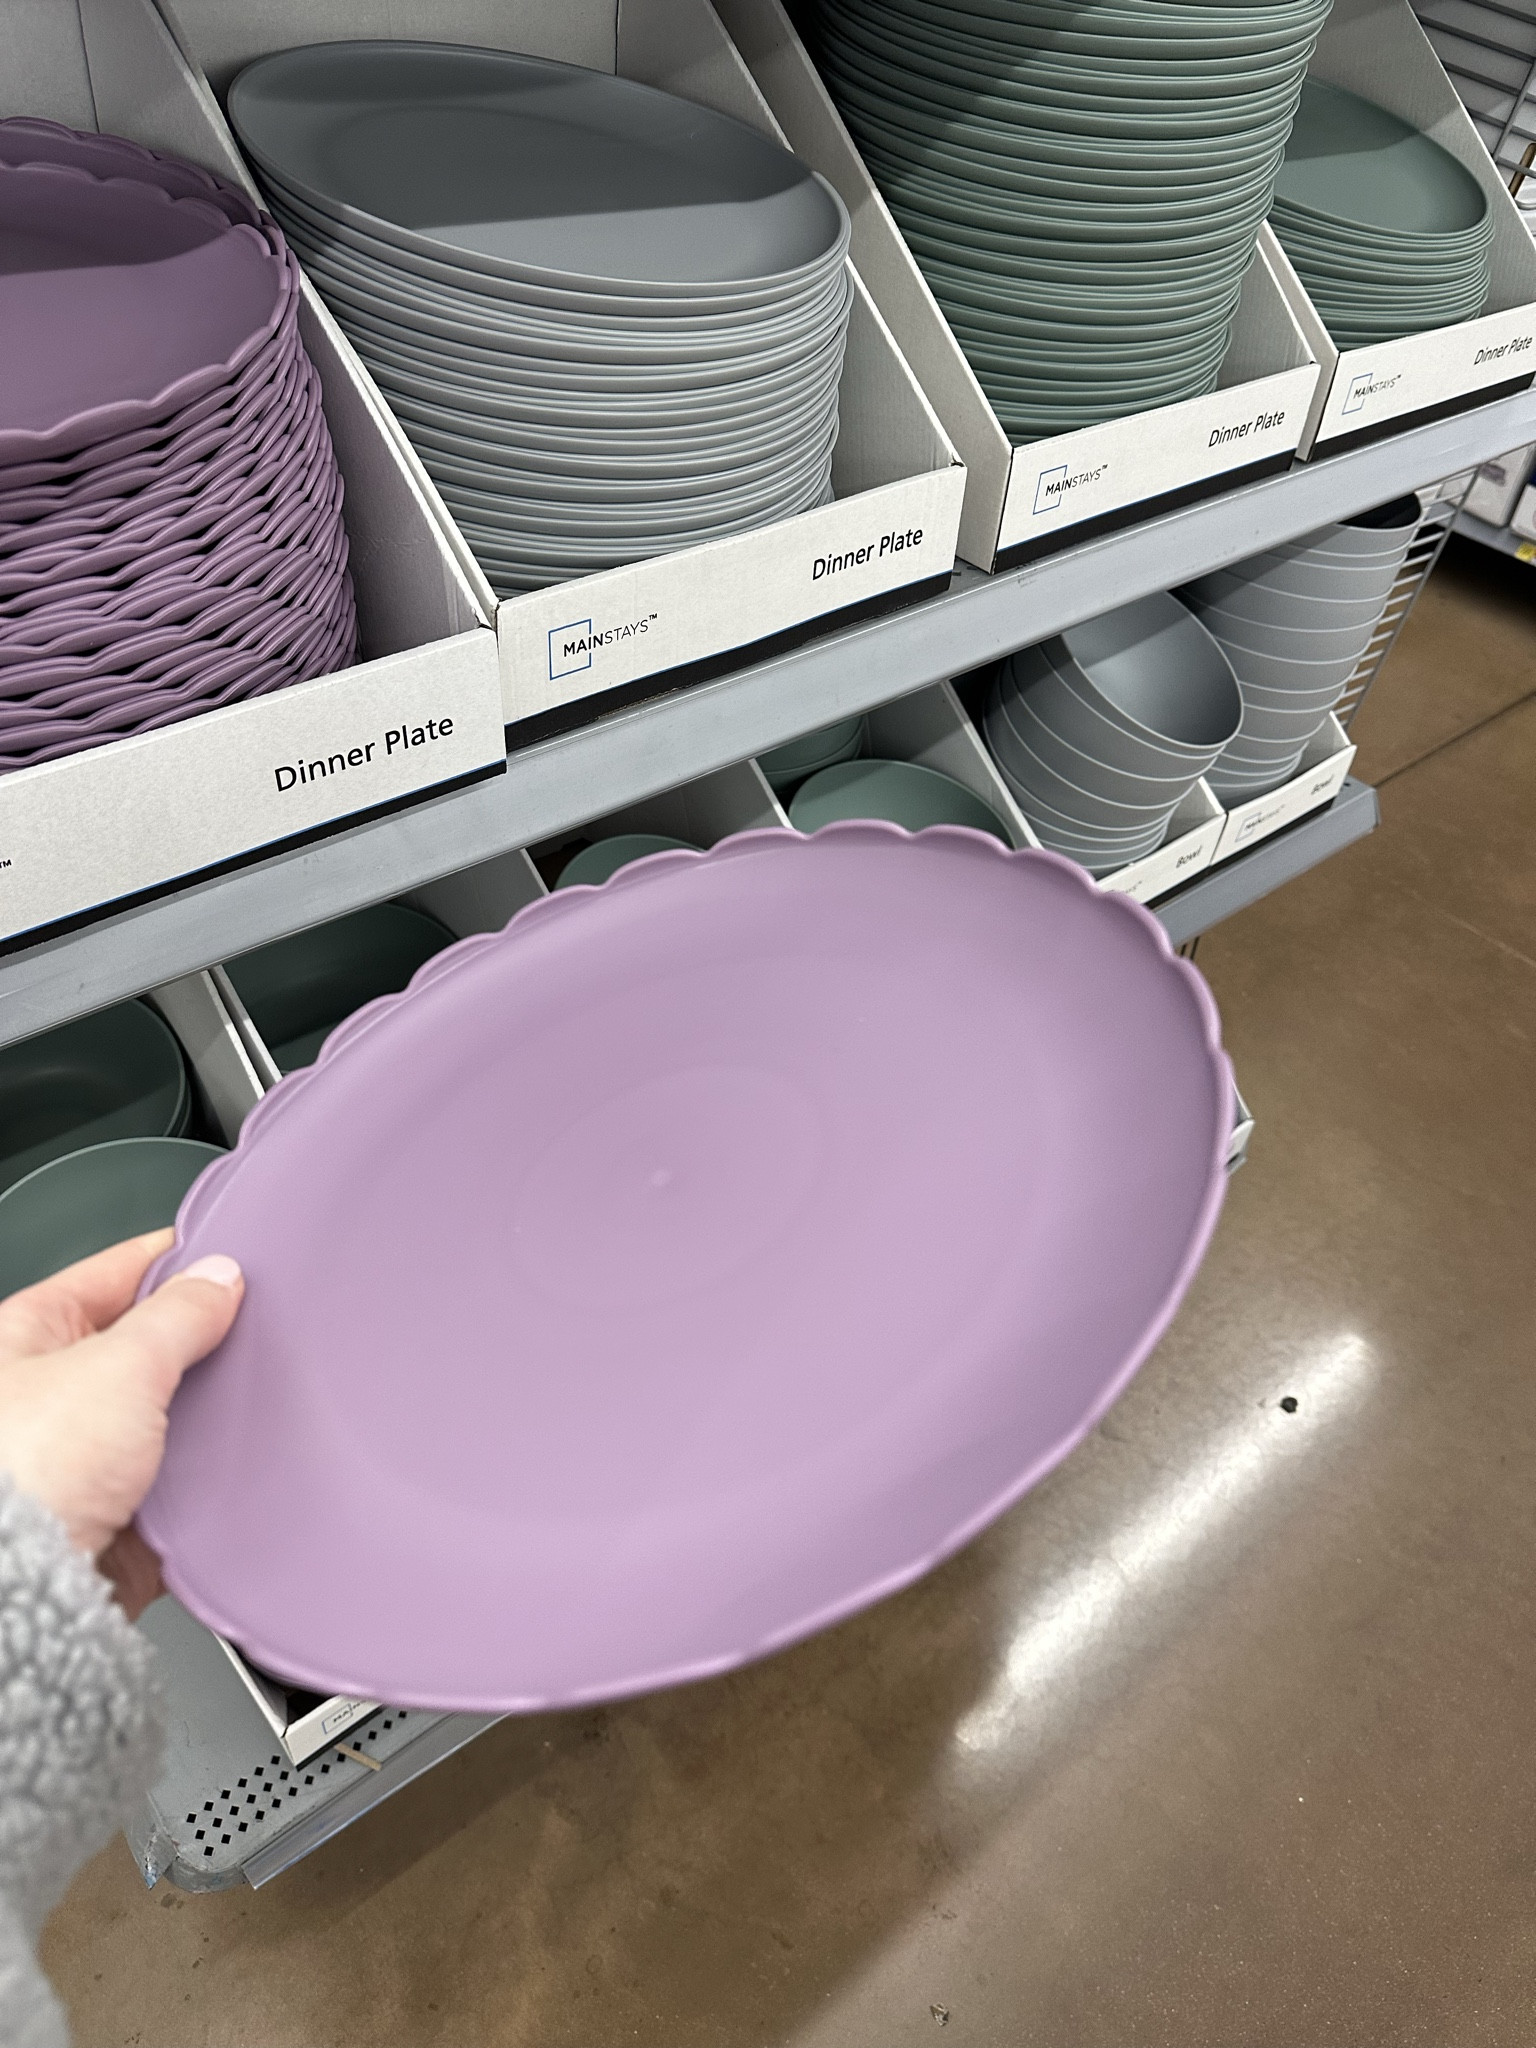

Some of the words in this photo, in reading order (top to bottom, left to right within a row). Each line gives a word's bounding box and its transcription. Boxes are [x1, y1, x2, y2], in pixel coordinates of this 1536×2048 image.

[1474, 345, 1509, 365] Dinner
[1508, 337, 1533, 354] Plate
[1208, 422, 1252, 448] Dinner
[1253, 411, 1285, 433] Plate
[812, 544, 874, 580] Dinner
[879, 528, 923, 557] Plate
[274, 743, 375, 793] Dinner
[385, 715, 454, 755] Plate
[1176, 846, 1202, 868] Bowl
